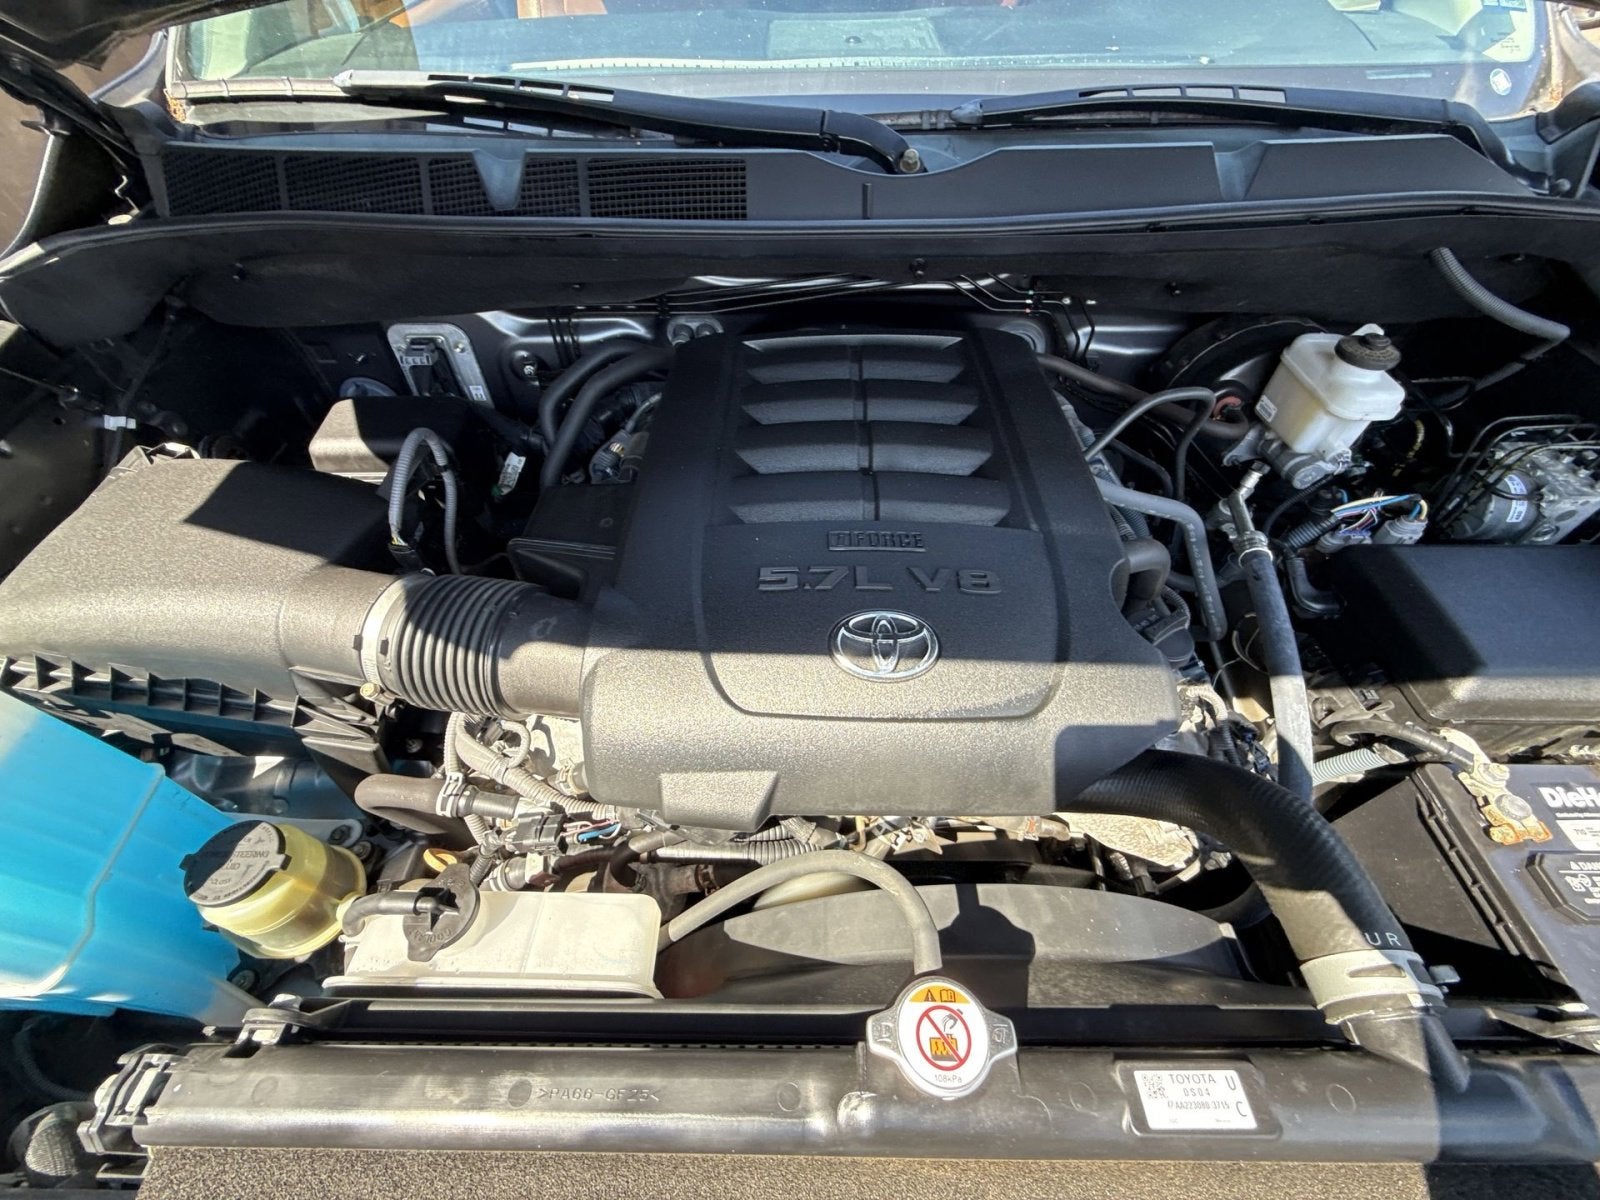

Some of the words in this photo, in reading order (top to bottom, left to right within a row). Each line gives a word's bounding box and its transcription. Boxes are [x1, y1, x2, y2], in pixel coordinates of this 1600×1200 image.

[757, 566, 894, 591] 5.7L
[906, 566, 1002, 595] V8
[1538, 787, 1600, 808] DieH
[1167, 1073, 1217, 1085] TOYOTA
[1224, 1075, 1237, 1091] U
[1235, 1101, 1248, 1117] C
